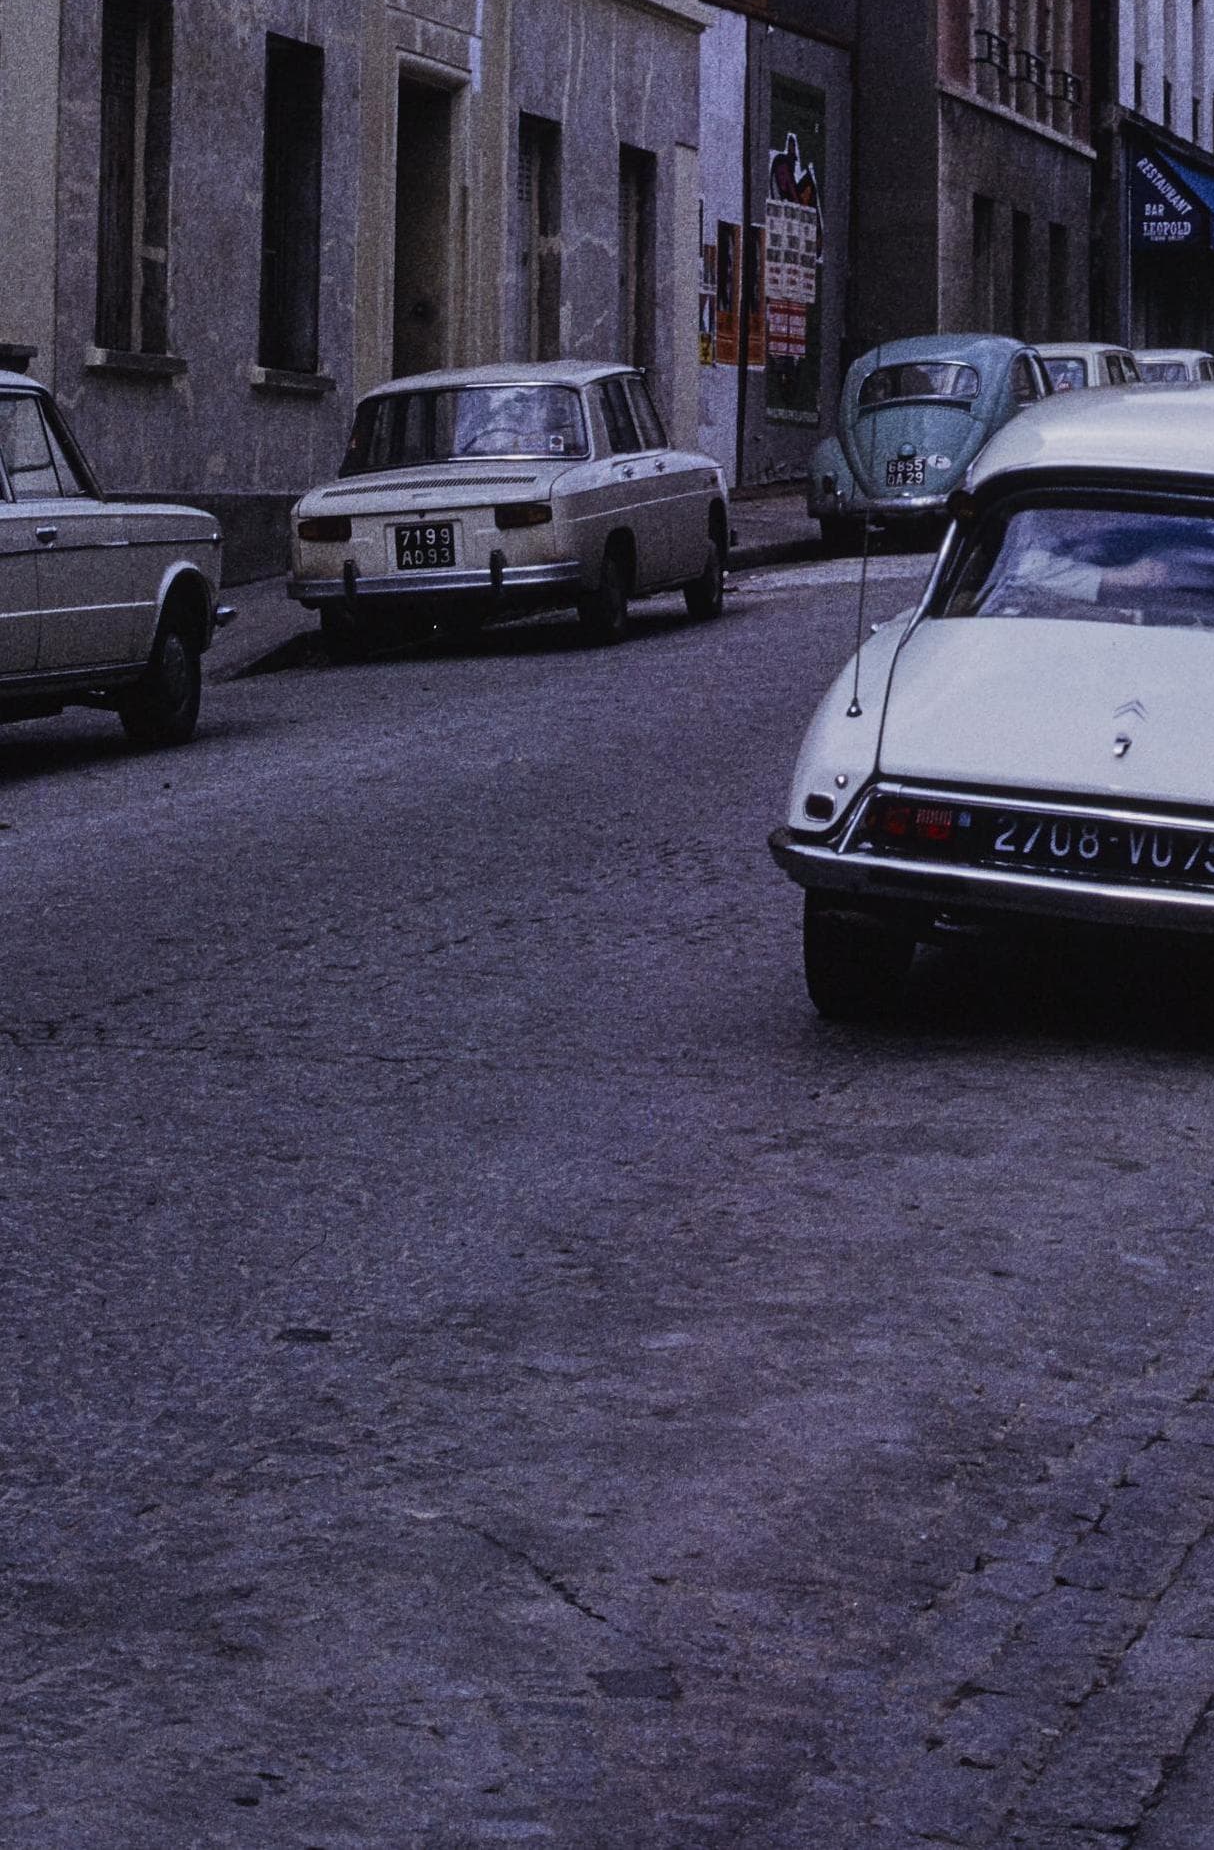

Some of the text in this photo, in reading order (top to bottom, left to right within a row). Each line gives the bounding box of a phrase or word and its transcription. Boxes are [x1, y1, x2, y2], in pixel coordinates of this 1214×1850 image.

[1136, 157, 1193, 215] RESTAURANT
[1144, 203, 1165, 216] BAR
[1142, 221, 1192, 237] LEOPOLD
[400, 528, 451, 547] 7199
